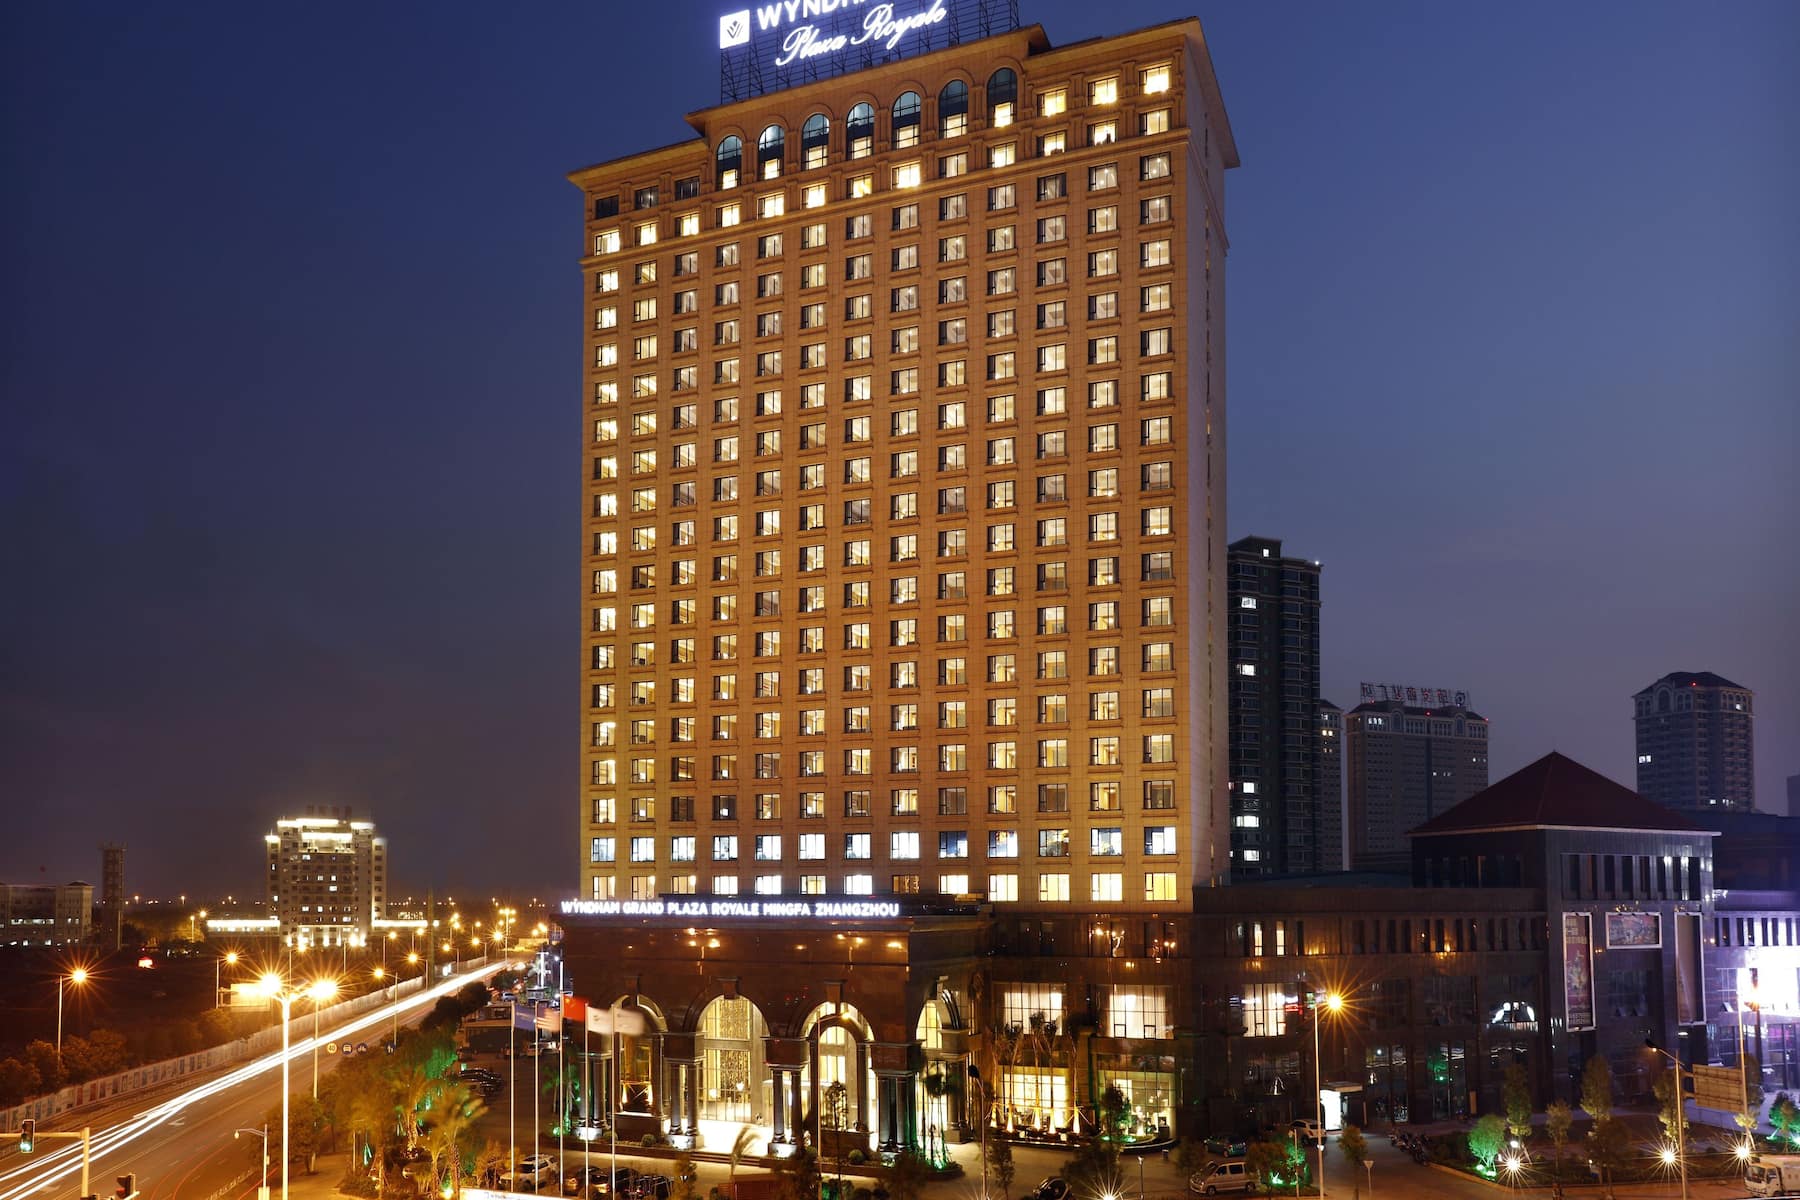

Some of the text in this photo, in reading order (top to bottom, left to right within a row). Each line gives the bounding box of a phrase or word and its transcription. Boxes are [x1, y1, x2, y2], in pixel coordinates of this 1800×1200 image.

[757, 0, 864, 30] WYND
[775, 0, 947, 66] Plaza Royale
[561, 901, 900, 917] WYNDHAM GRAND PLAZA ROYALE MINGFA ZHANGZHOU
